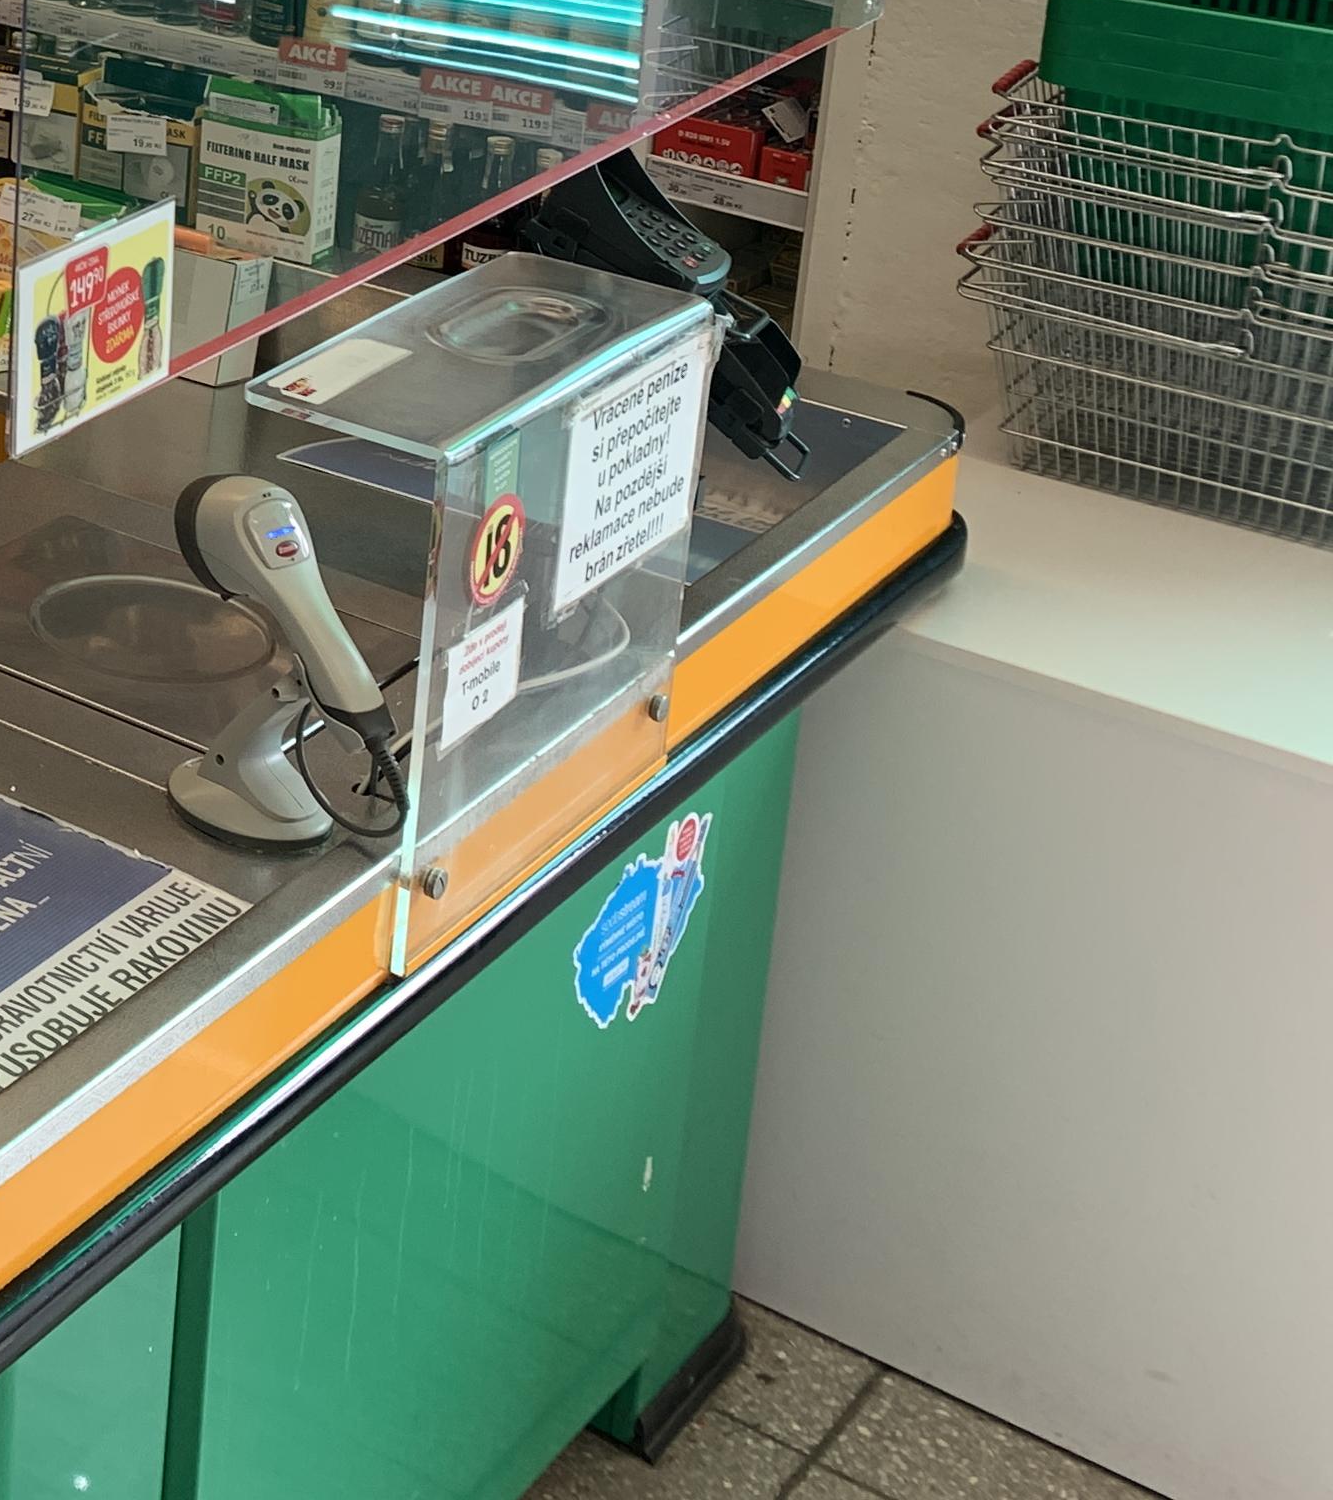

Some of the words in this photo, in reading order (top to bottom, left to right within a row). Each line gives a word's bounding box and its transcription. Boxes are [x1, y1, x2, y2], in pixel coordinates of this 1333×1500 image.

[206, 140, 252, 161] FILTERING
[253, 151, 278, 166] HALF
[279, 156, 310, 171] MASK
[204, 166, 242, 186] FFP2
[208, 223, 226, 240] 10
[591, 443, 605, 464] si
[608, 426, 671, 485] pokladny!
[568, 510, 636, 565] reklamace
[637, 474, 685, 516] nebude
[593, 493, 613, 521] Na
[461, 659, 502, 697] T-mobile
[119, 877, 210, 952] VARUJE:
[124, 896, 242, 999] RAKOVINU
